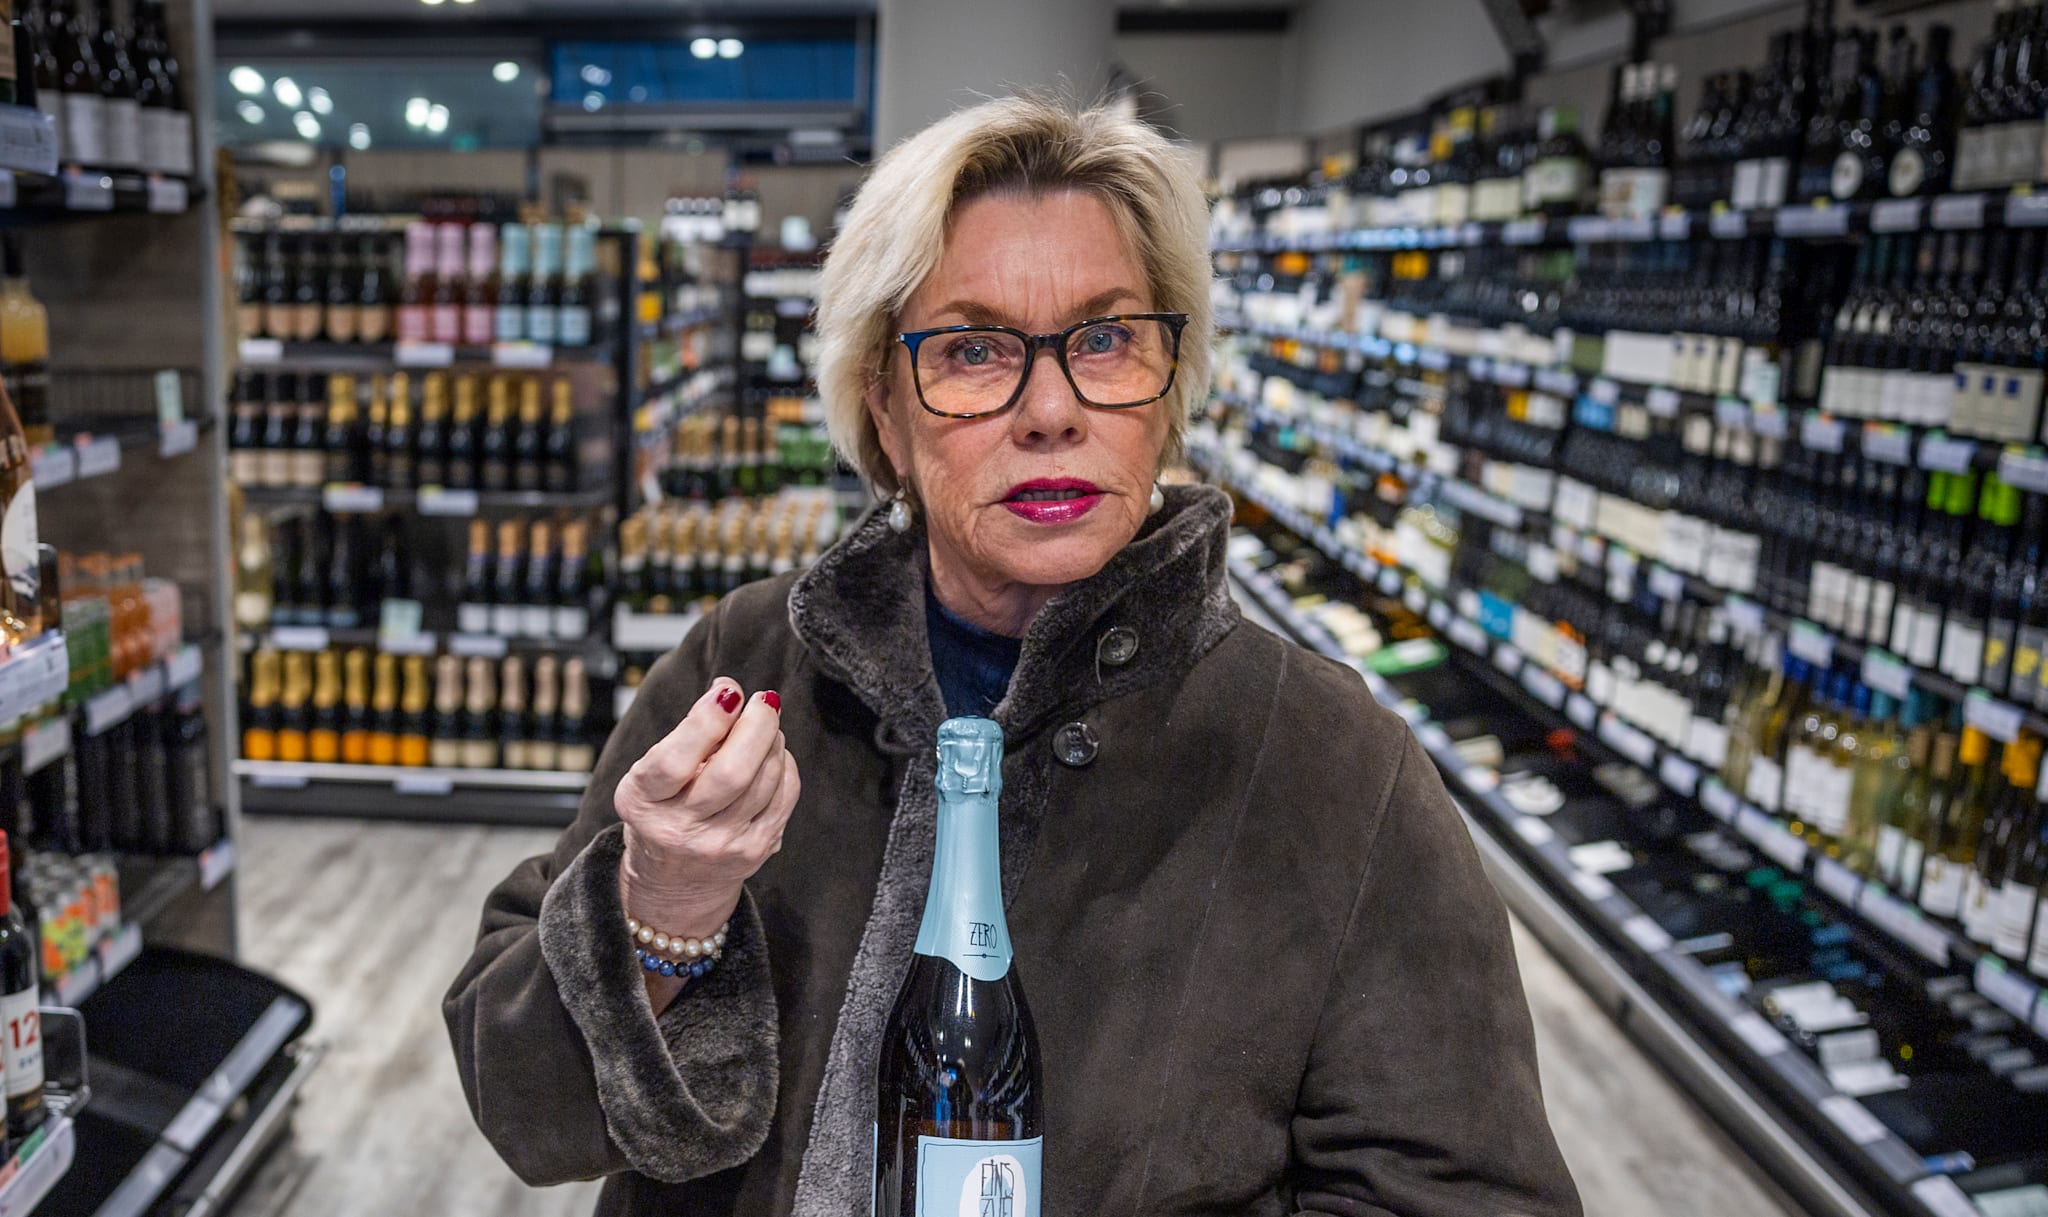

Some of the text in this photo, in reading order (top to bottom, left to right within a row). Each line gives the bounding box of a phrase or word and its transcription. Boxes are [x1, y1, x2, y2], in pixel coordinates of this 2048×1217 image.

[969, 921, 997, 949] ZERO
[9, 1011, 39, 1050] 12
[980, 1159, 1015, 1199] EINS
